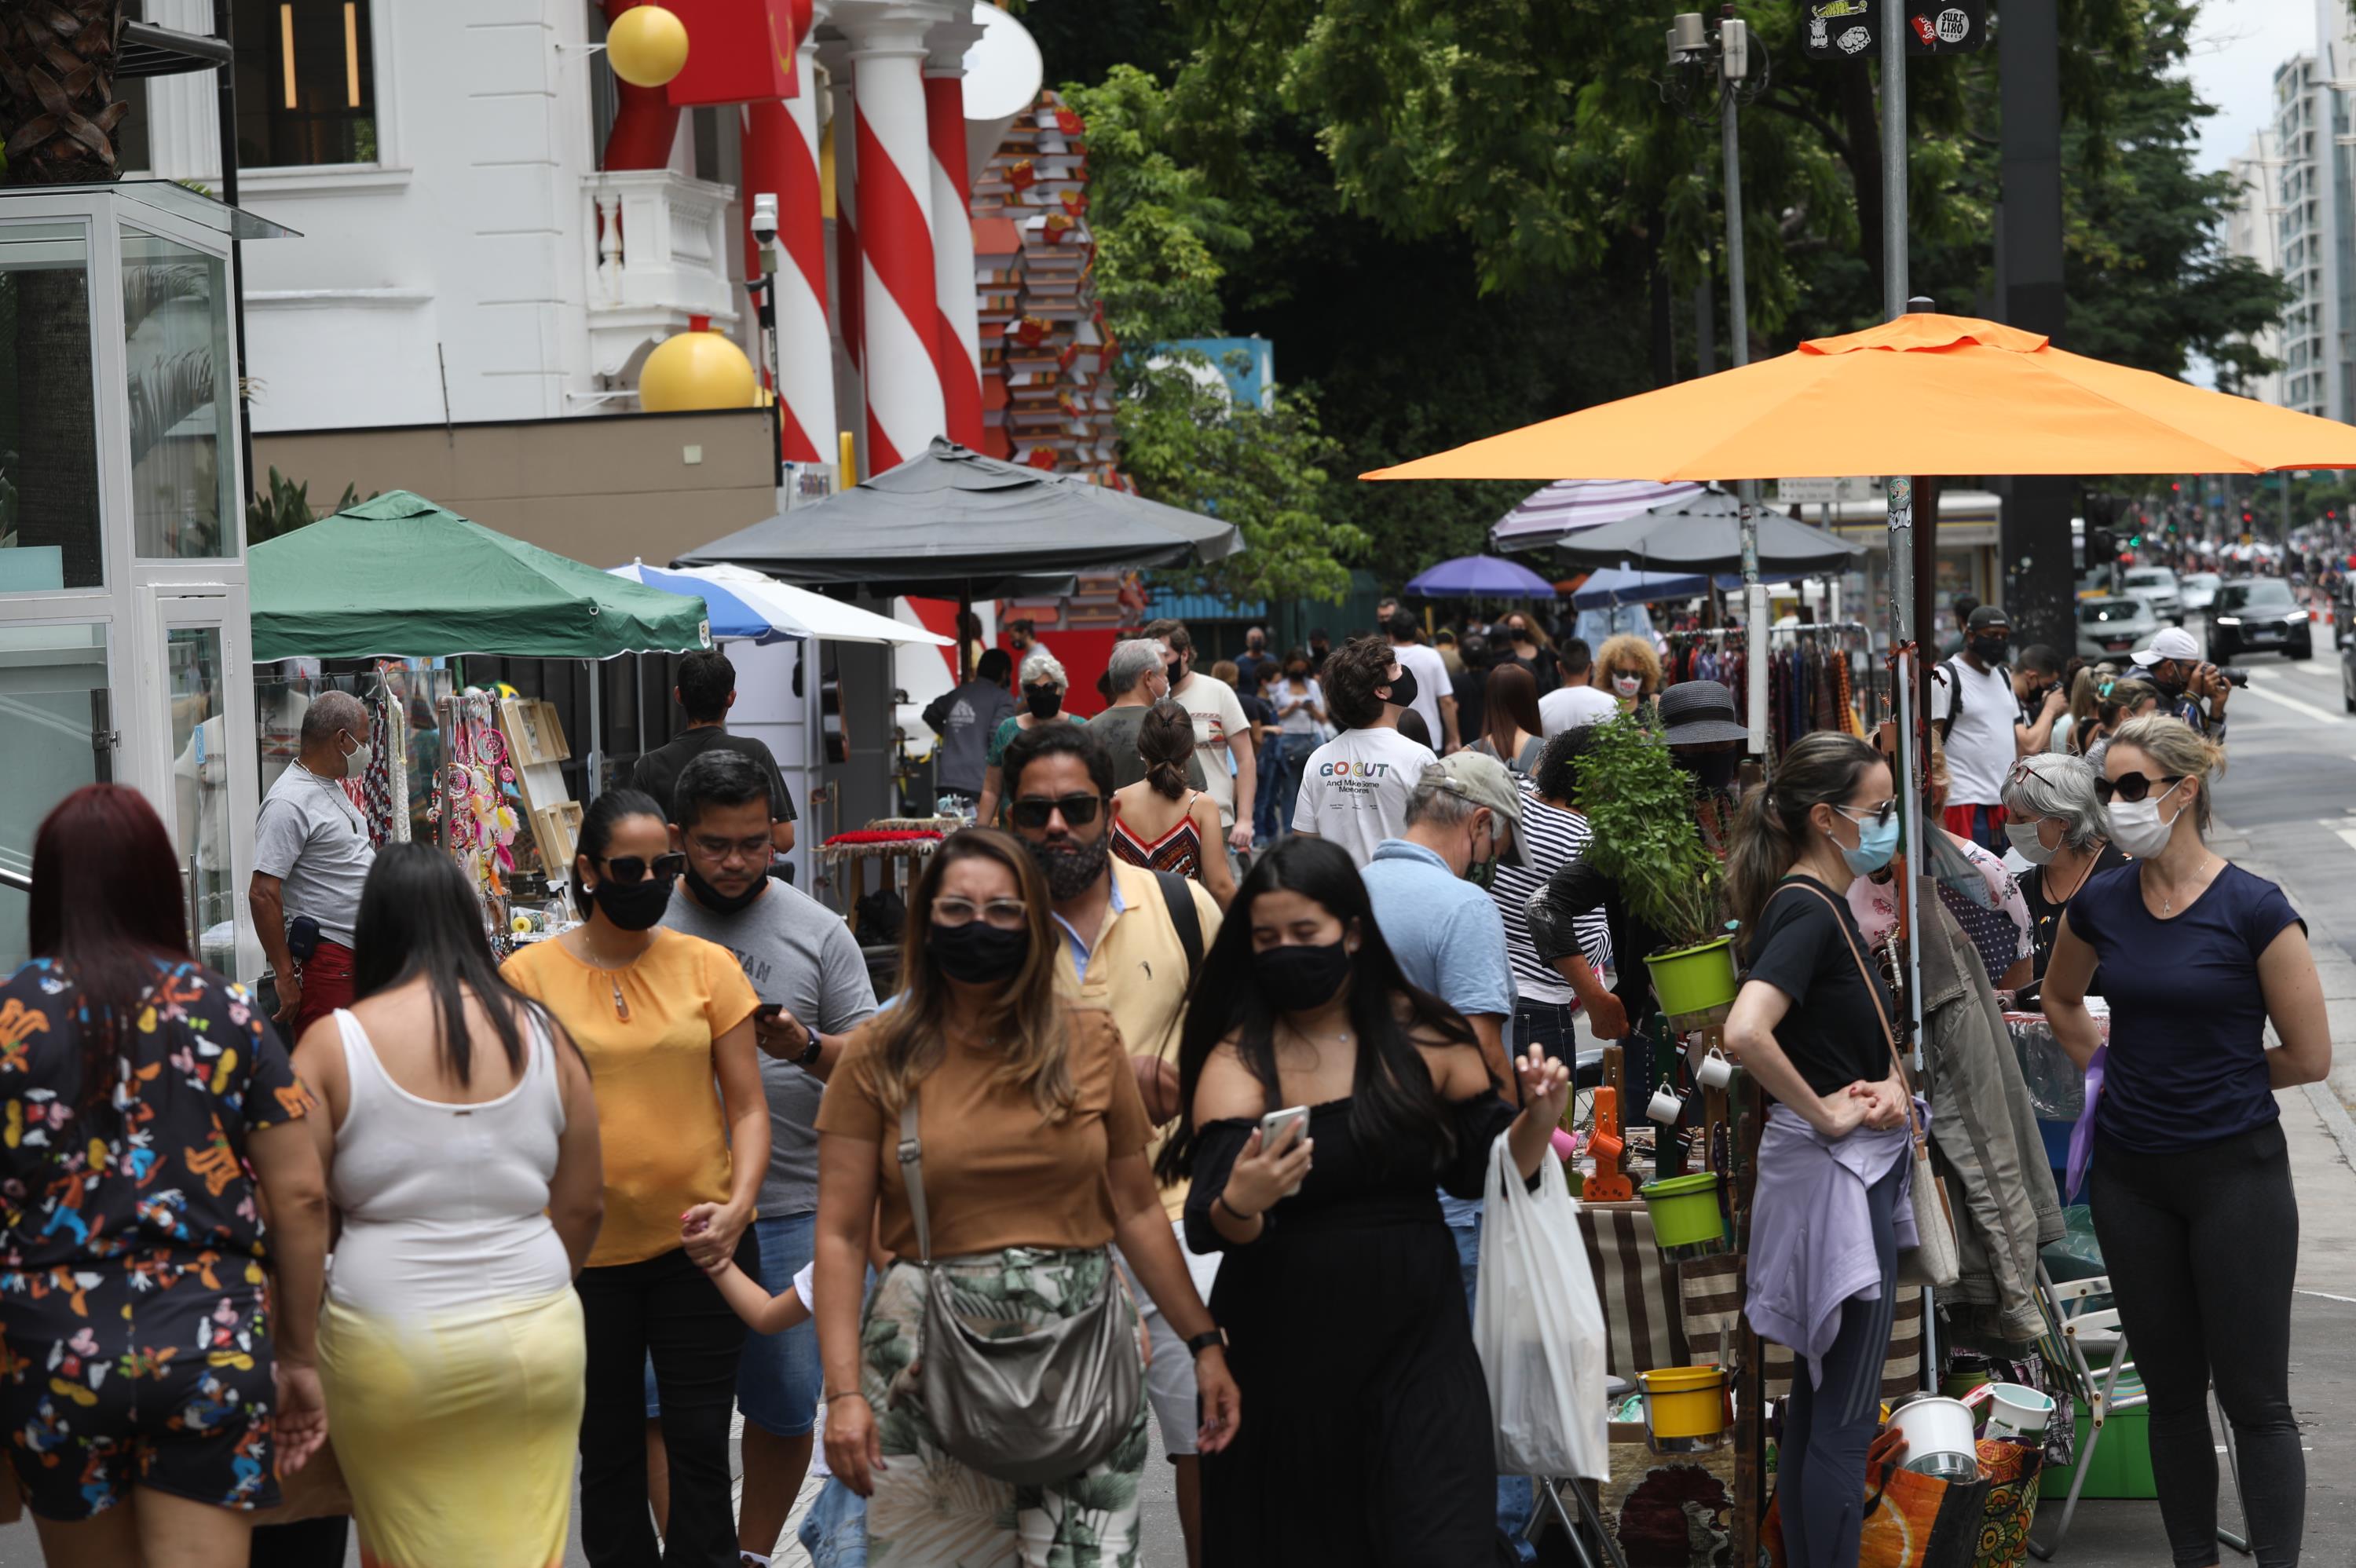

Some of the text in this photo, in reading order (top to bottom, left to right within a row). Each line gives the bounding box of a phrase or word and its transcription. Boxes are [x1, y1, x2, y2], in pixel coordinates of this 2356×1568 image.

[1941, 13, 1965, 23] SURF
[1941, 22, 1963, 34] LIXO
[1320, 762, 1349, 777] GO
